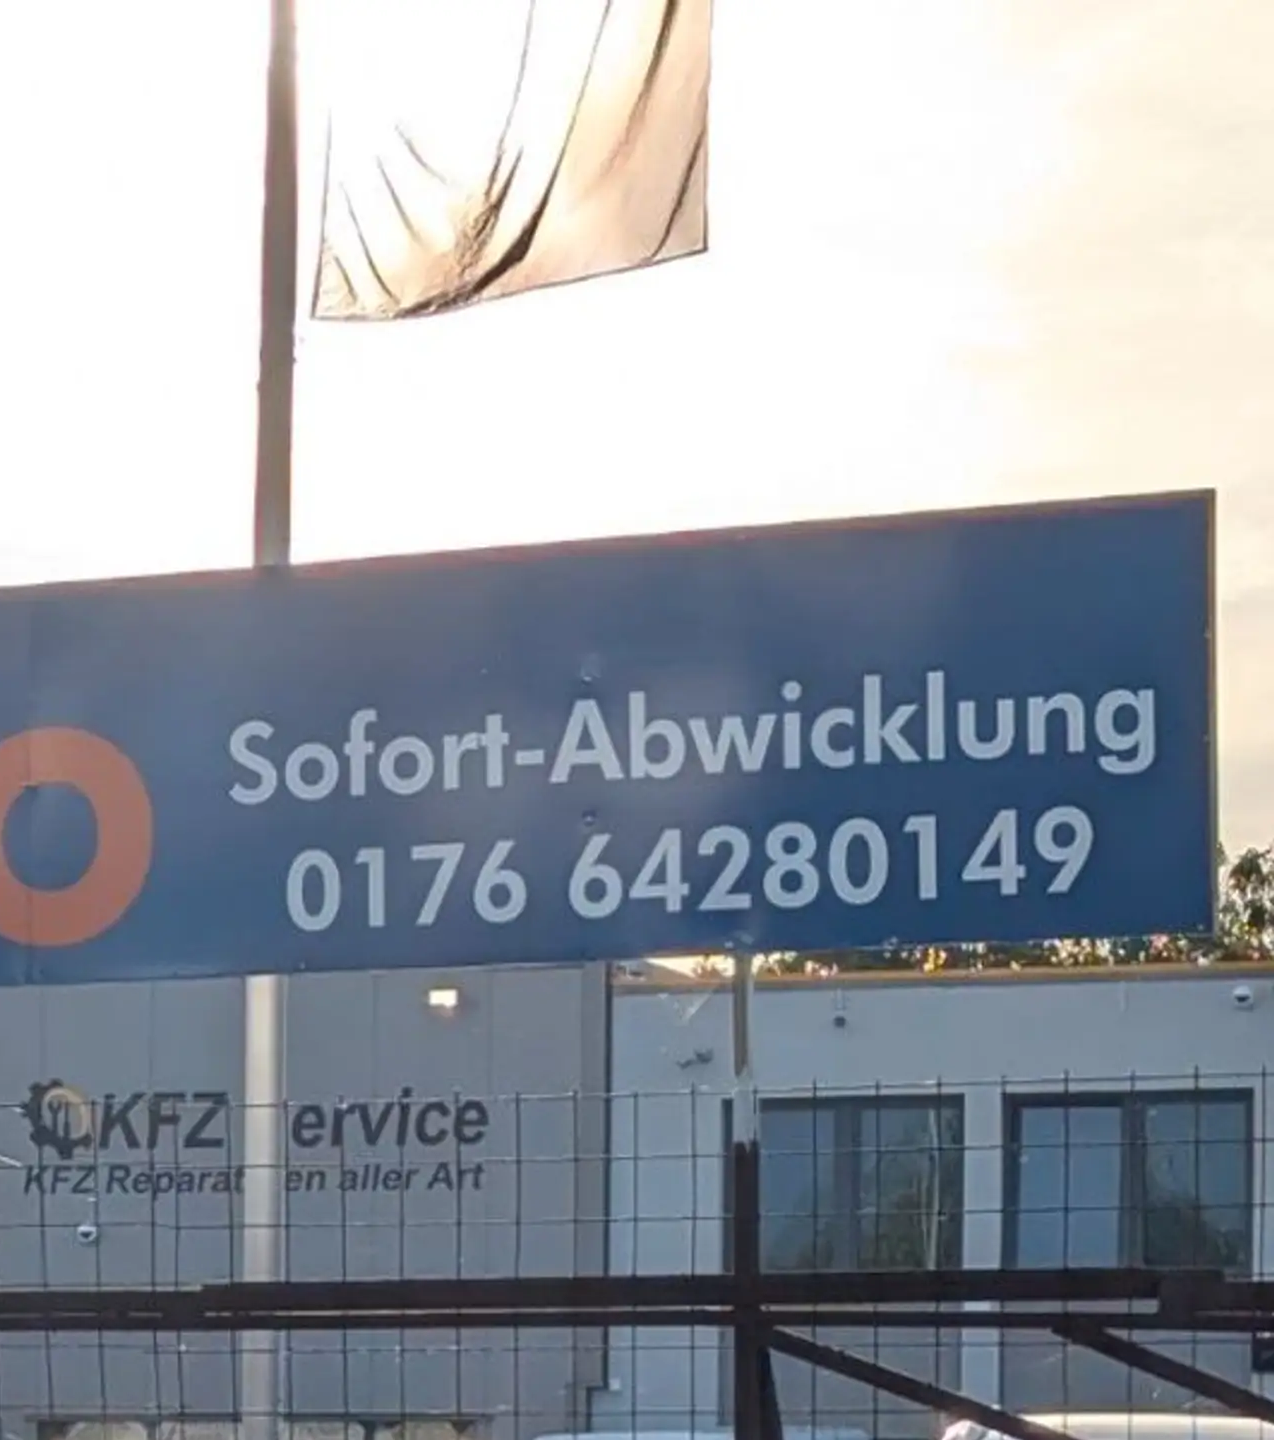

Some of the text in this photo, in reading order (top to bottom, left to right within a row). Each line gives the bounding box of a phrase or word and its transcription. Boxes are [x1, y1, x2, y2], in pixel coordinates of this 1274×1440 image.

[228, 669, 1157, 806] Sofort-Abwicklung
[285, 805, 1095, 932] 0176 64280149
[99, 1087, 489, 1150] KFZ ervice
[25, 1165, 96, 1195] KFZ
[339, 1163, 420, 1192] aller
[427, 1162, 485, 1191] Art
